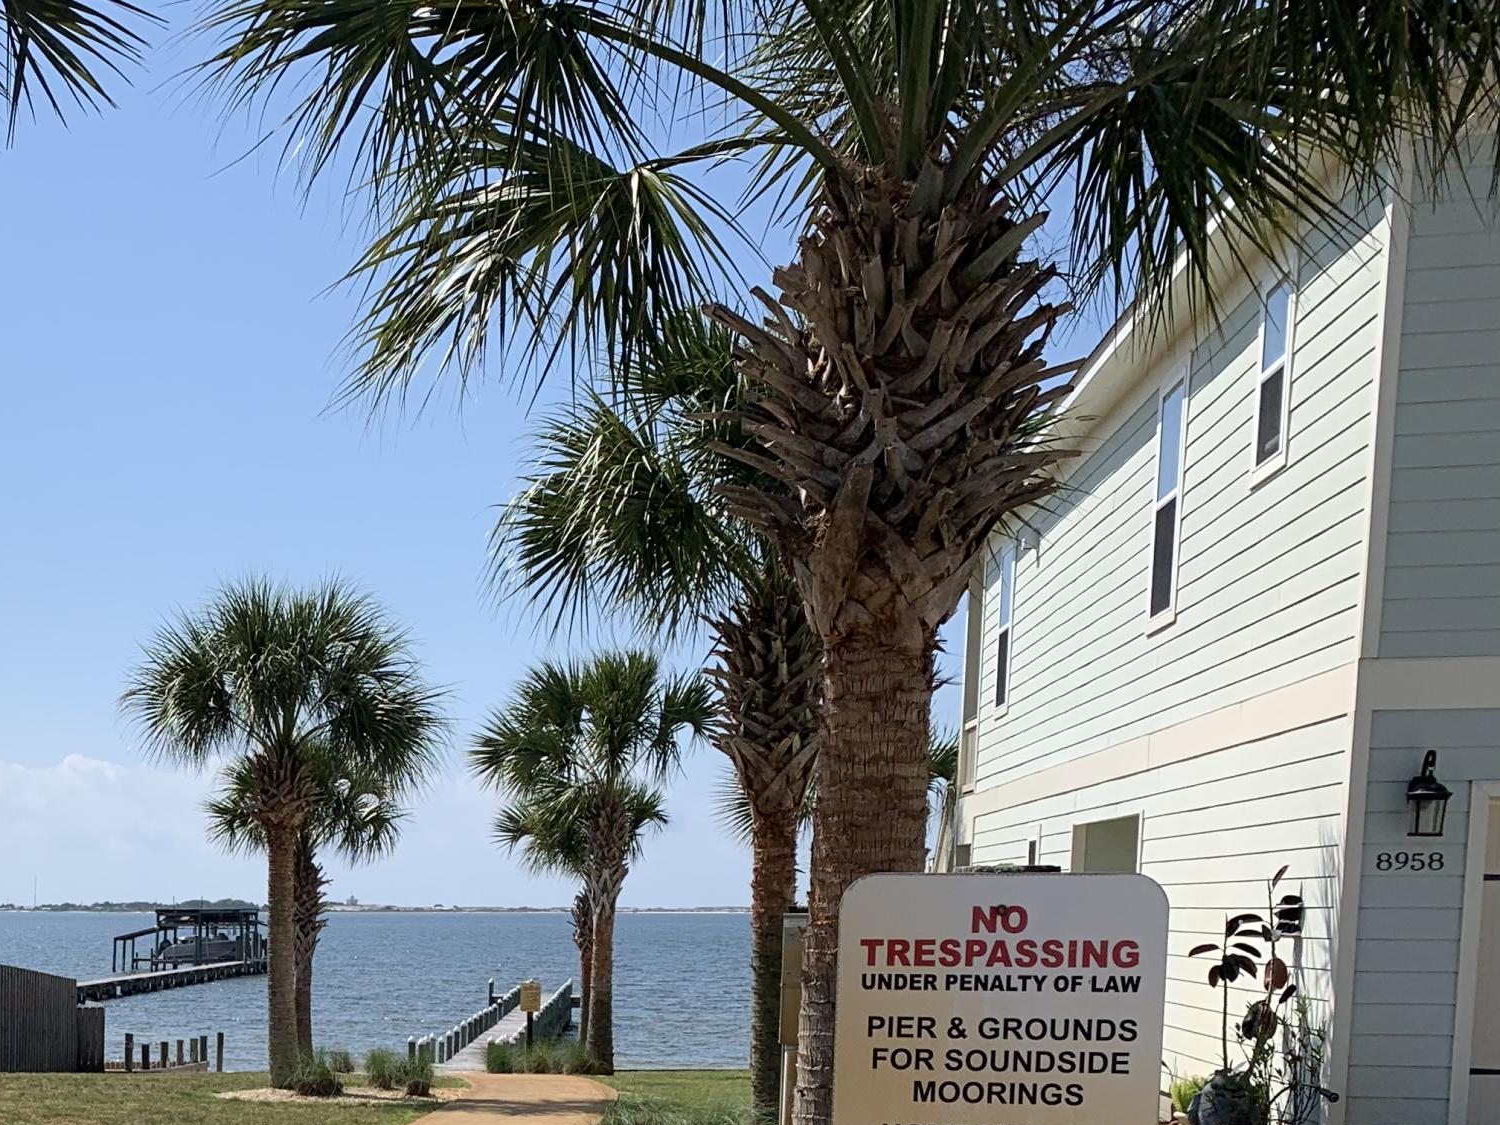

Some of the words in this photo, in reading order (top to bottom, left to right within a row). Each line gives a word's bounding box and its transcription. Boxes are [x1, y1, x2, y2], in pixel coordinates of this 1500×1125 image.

[1376, 852, 1444, 871] 8958
[971, 905, 1028, 933] NO
[860, 939, 1140, 968] TRESPASSING
[861, 974, 937, 990] UNDER
[945, 974, 1047, 992] PENALTY
[1054, 975, 1083, 992] OF
[1091, 976, 1141, 993] LAW
[867, 1016, 937, 1038] PIER
[947, 1017, 967, 1039] &
[978, 1017, 1138, 1041] GROUNDS
[871, 1048, 934, 1070] FOR
[945, 1049, 1130, 1074] SOUNDSIDE
[913, 1080, 1084, 1106] MOORINGS
